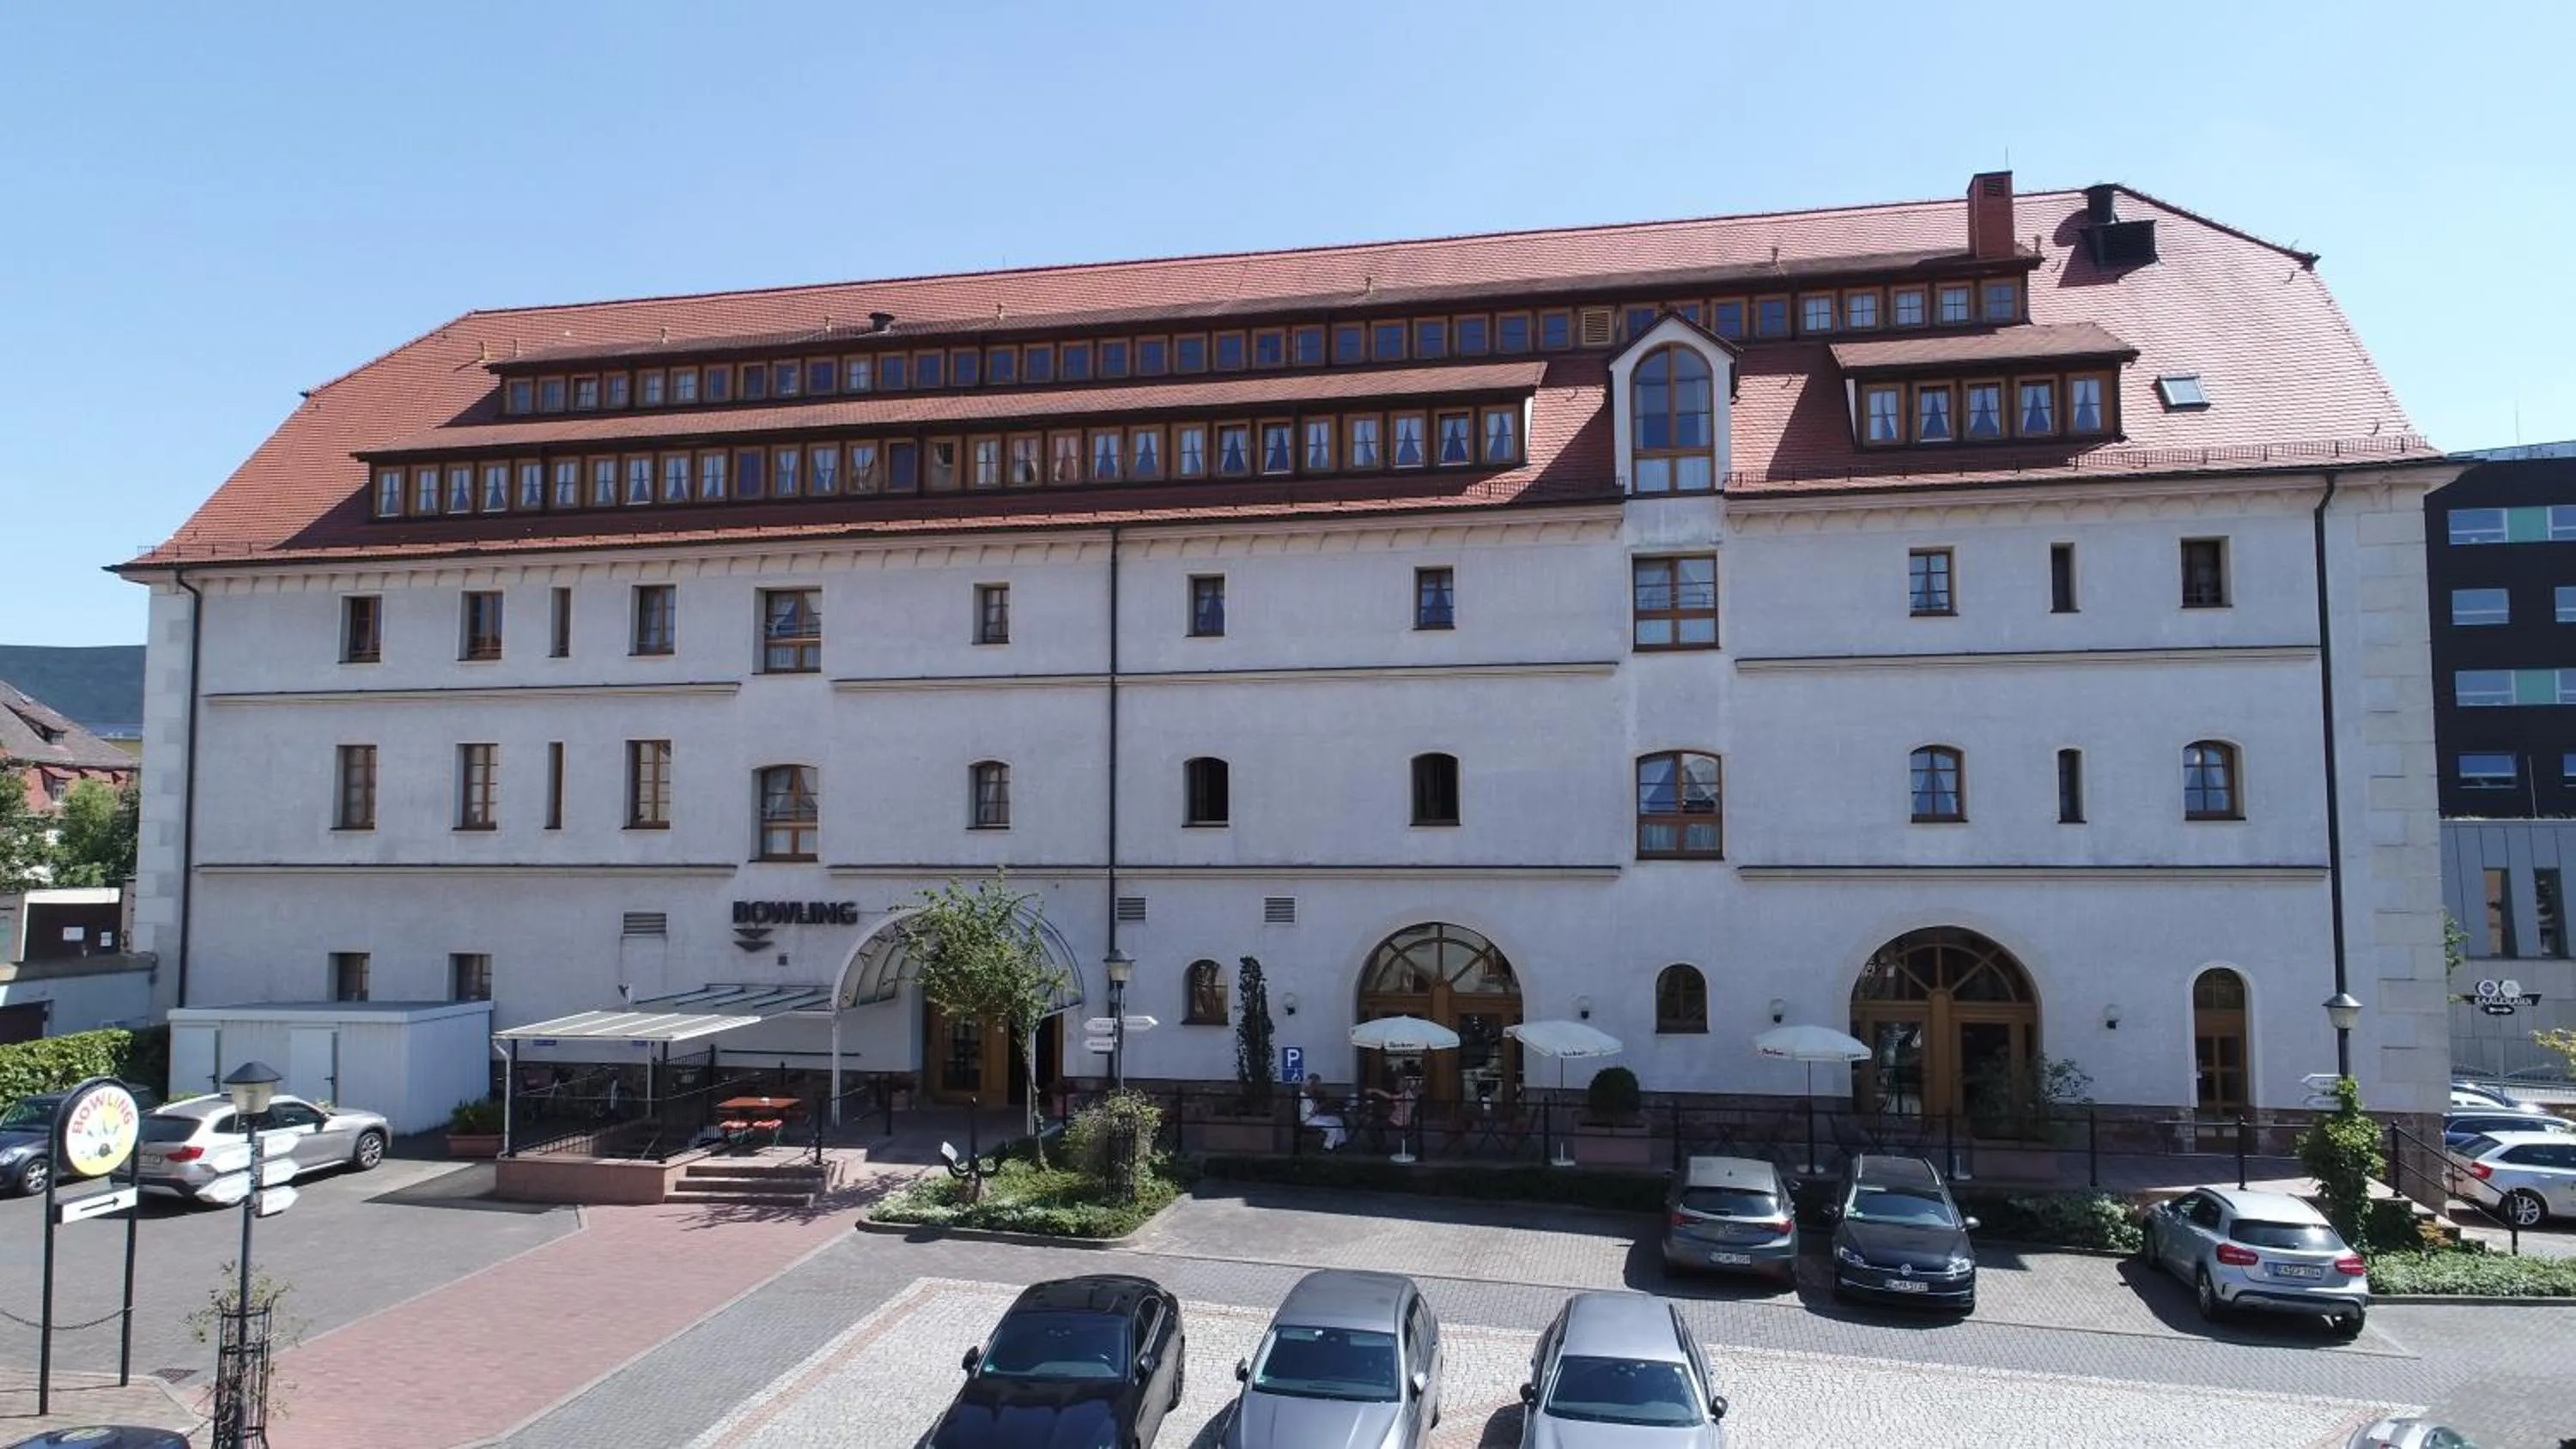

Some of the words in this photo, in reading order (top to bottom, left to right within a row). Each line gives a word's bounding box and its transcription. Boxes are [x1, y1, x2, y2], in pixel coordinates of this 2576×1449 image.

[733, 901, 858, 925] BOWLING
[1287, 1048, 1299, 1067] P
[72, 1091, 135, 1135] BOWLING
